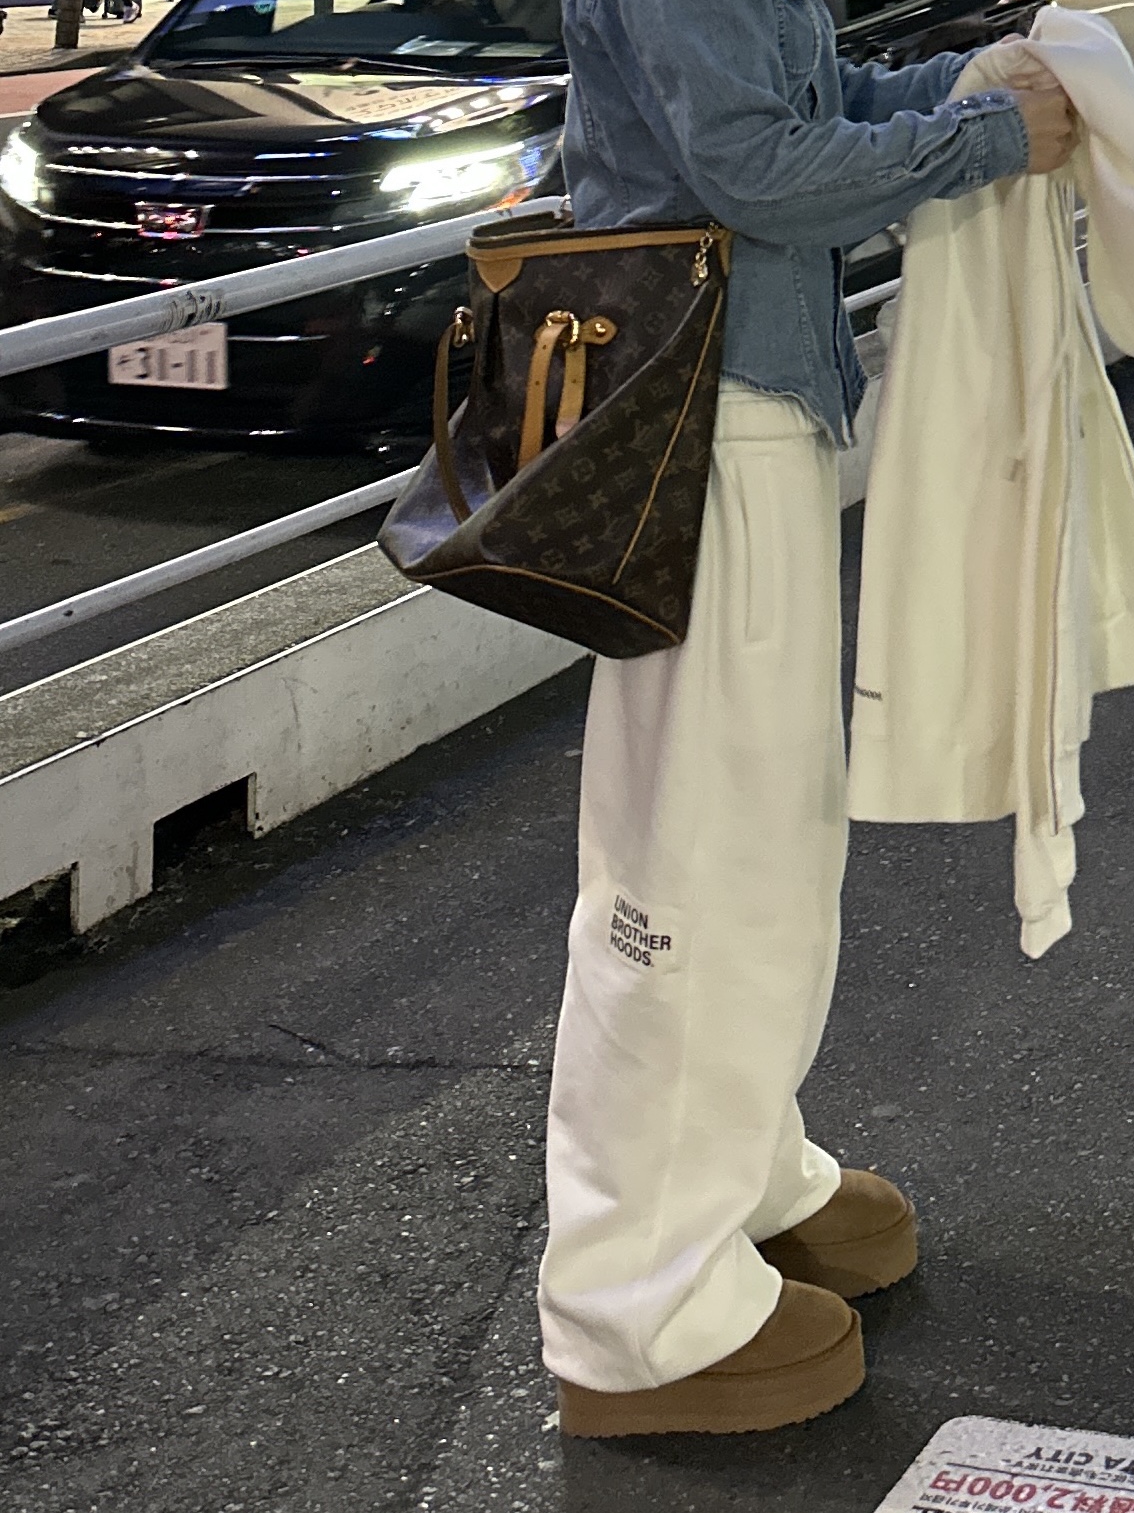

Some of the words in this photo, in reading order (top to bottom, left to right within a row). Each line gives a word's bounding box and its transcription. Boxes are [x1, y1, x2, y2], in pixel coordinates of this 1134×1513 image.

[614, 894, 649, 930] UNION
[610, 932, 655, 968] HOODS.
[611, 913, 672, 951] BROTHER
[1024, 1445, 1099, 1467] CITY
